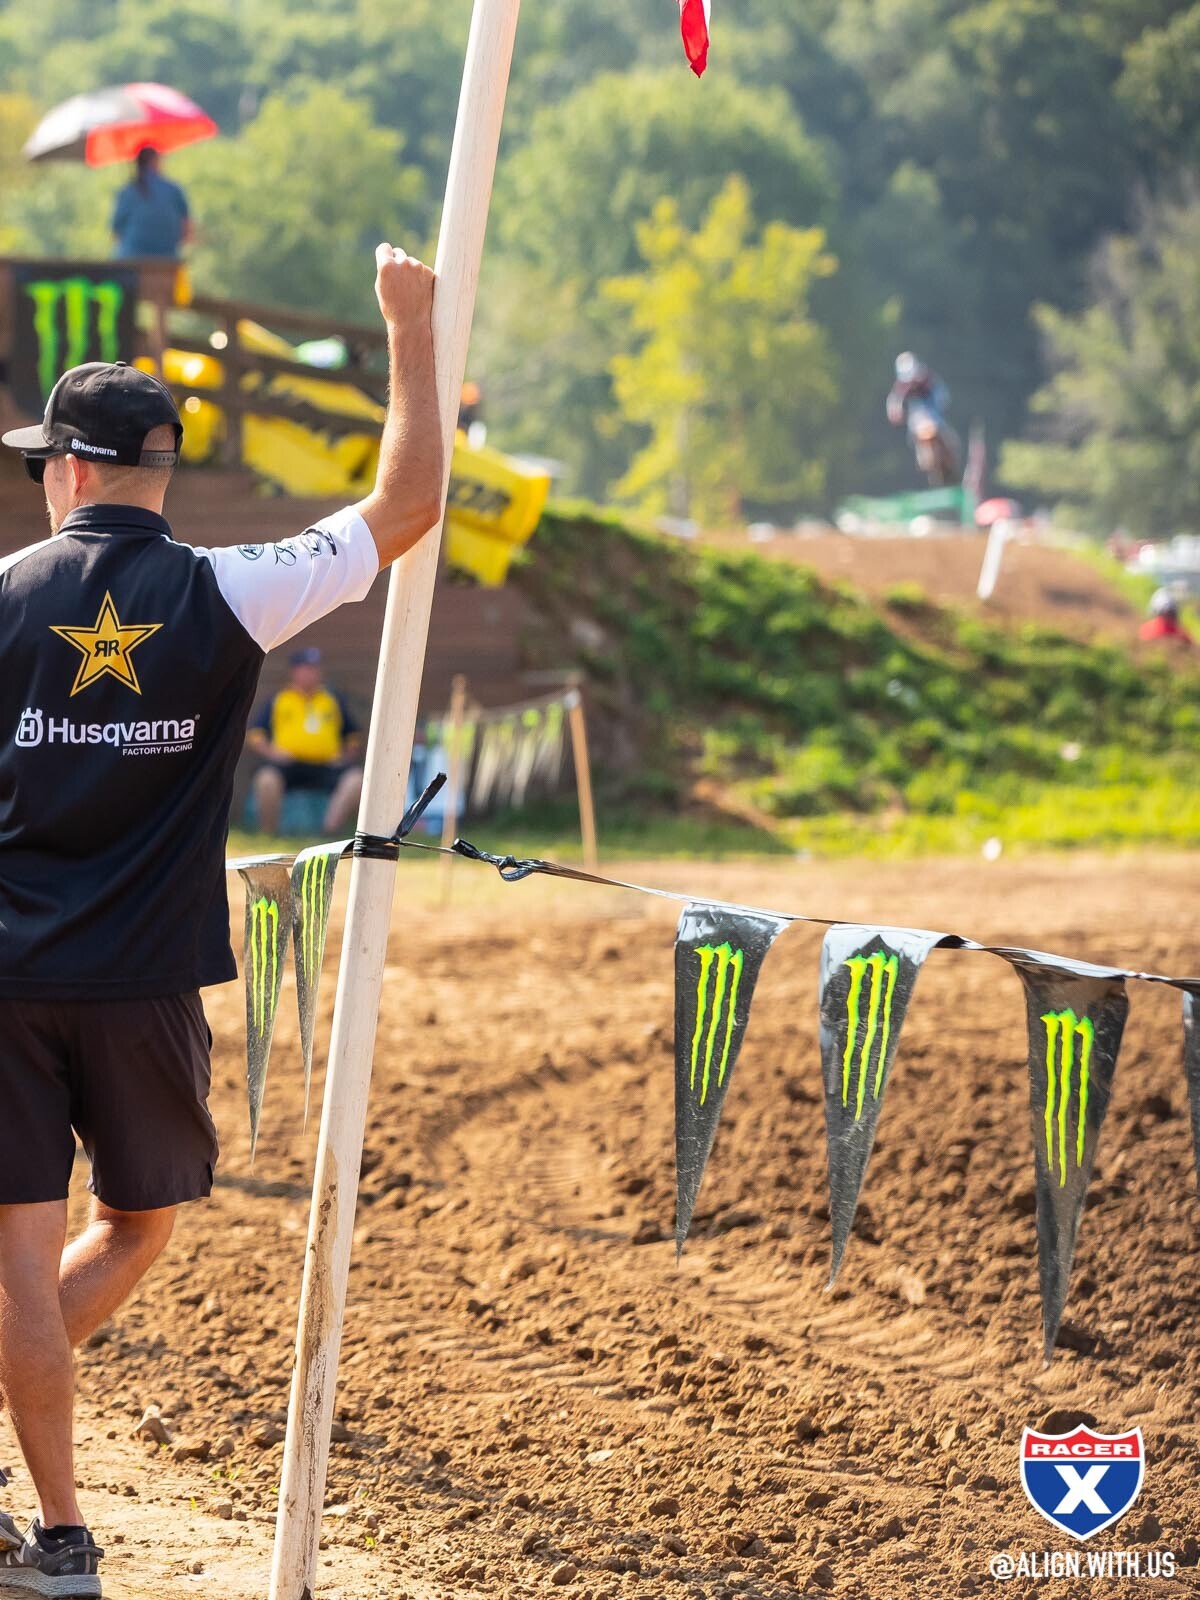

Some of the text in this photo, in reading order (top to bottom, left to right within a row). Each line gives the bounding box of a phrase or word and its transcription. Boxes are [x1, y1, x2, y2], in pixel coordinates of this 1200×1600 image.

[78, 441, 117, 456] Husqvarna
[48, 717, 195, 747] Husqvarna
[122, 742, 193, 756] FACTORY RACING
